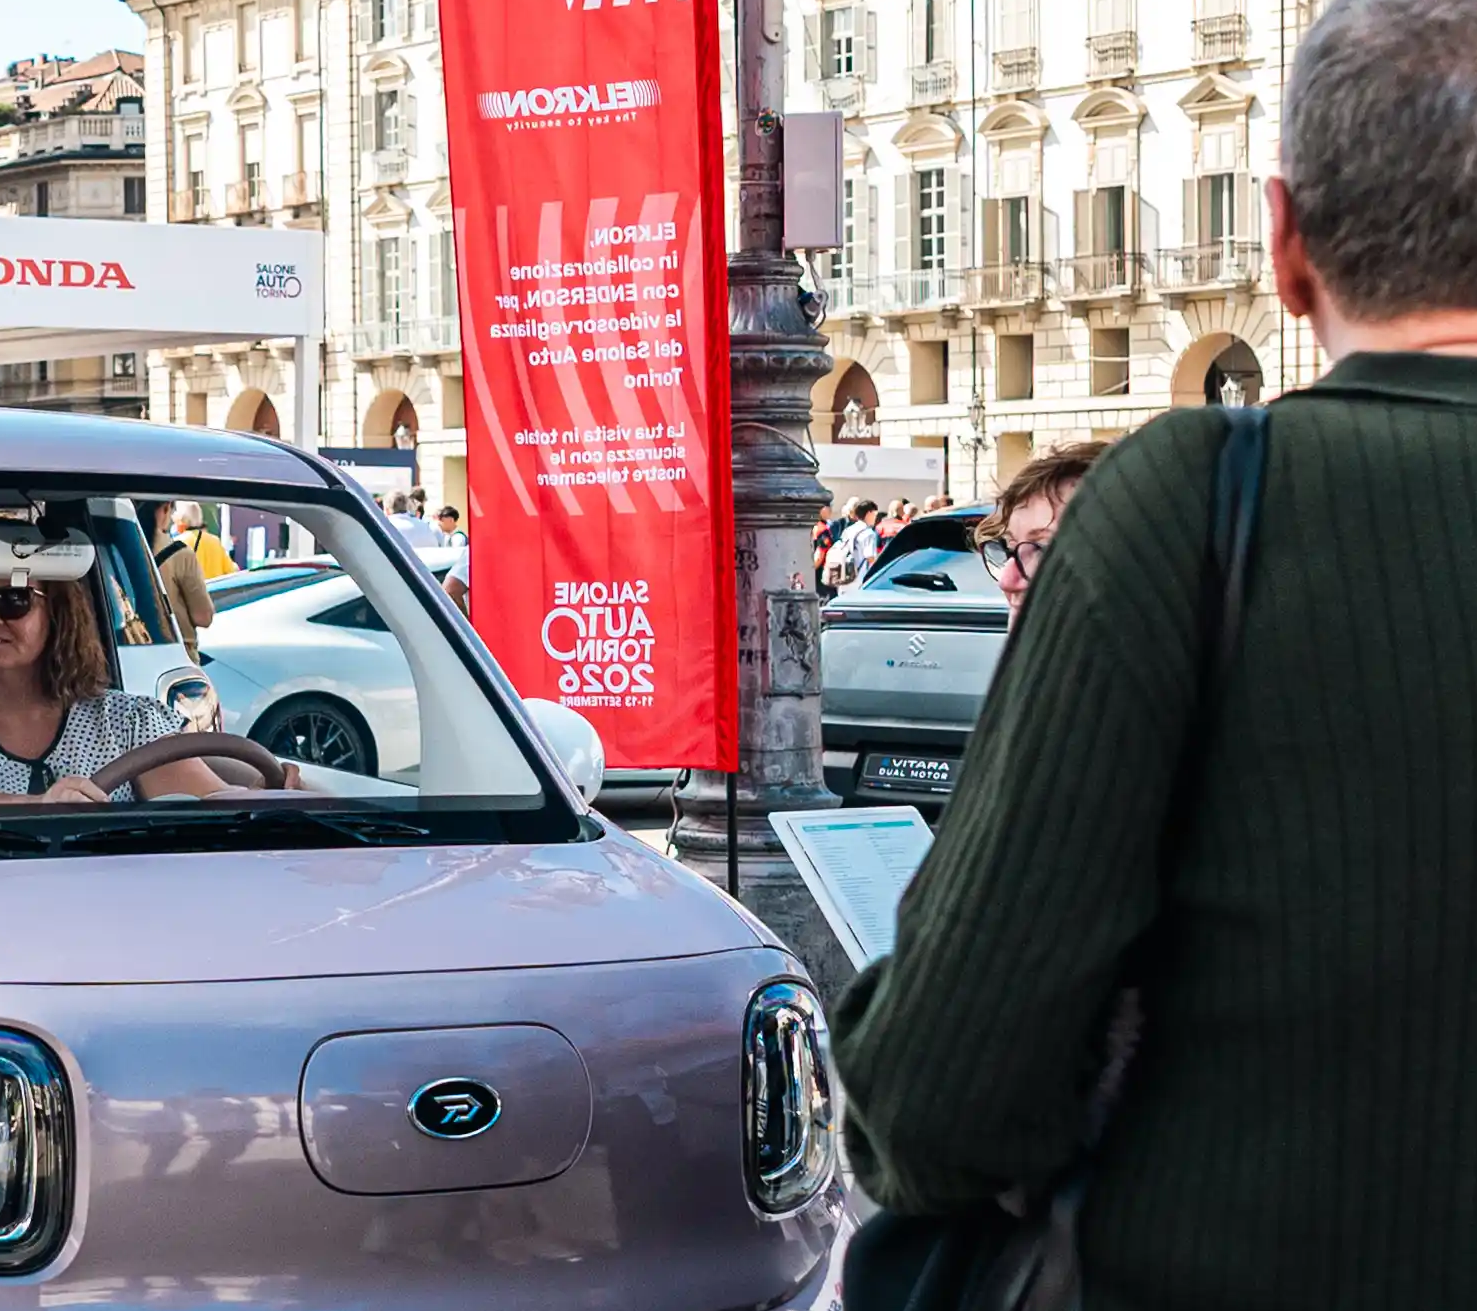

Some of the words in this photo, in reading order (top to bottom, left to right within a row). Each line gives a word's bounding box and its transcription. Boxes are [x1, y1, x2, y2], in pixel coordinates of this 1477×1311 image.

[255, 263, 297, 275] SALONE
[255, 275, 302, 298] AUTO
[255, 287, 302, 299] TORINO
[878, 767, 906, 778] DUAL
[910, 769, 948, 781] MOTOR
